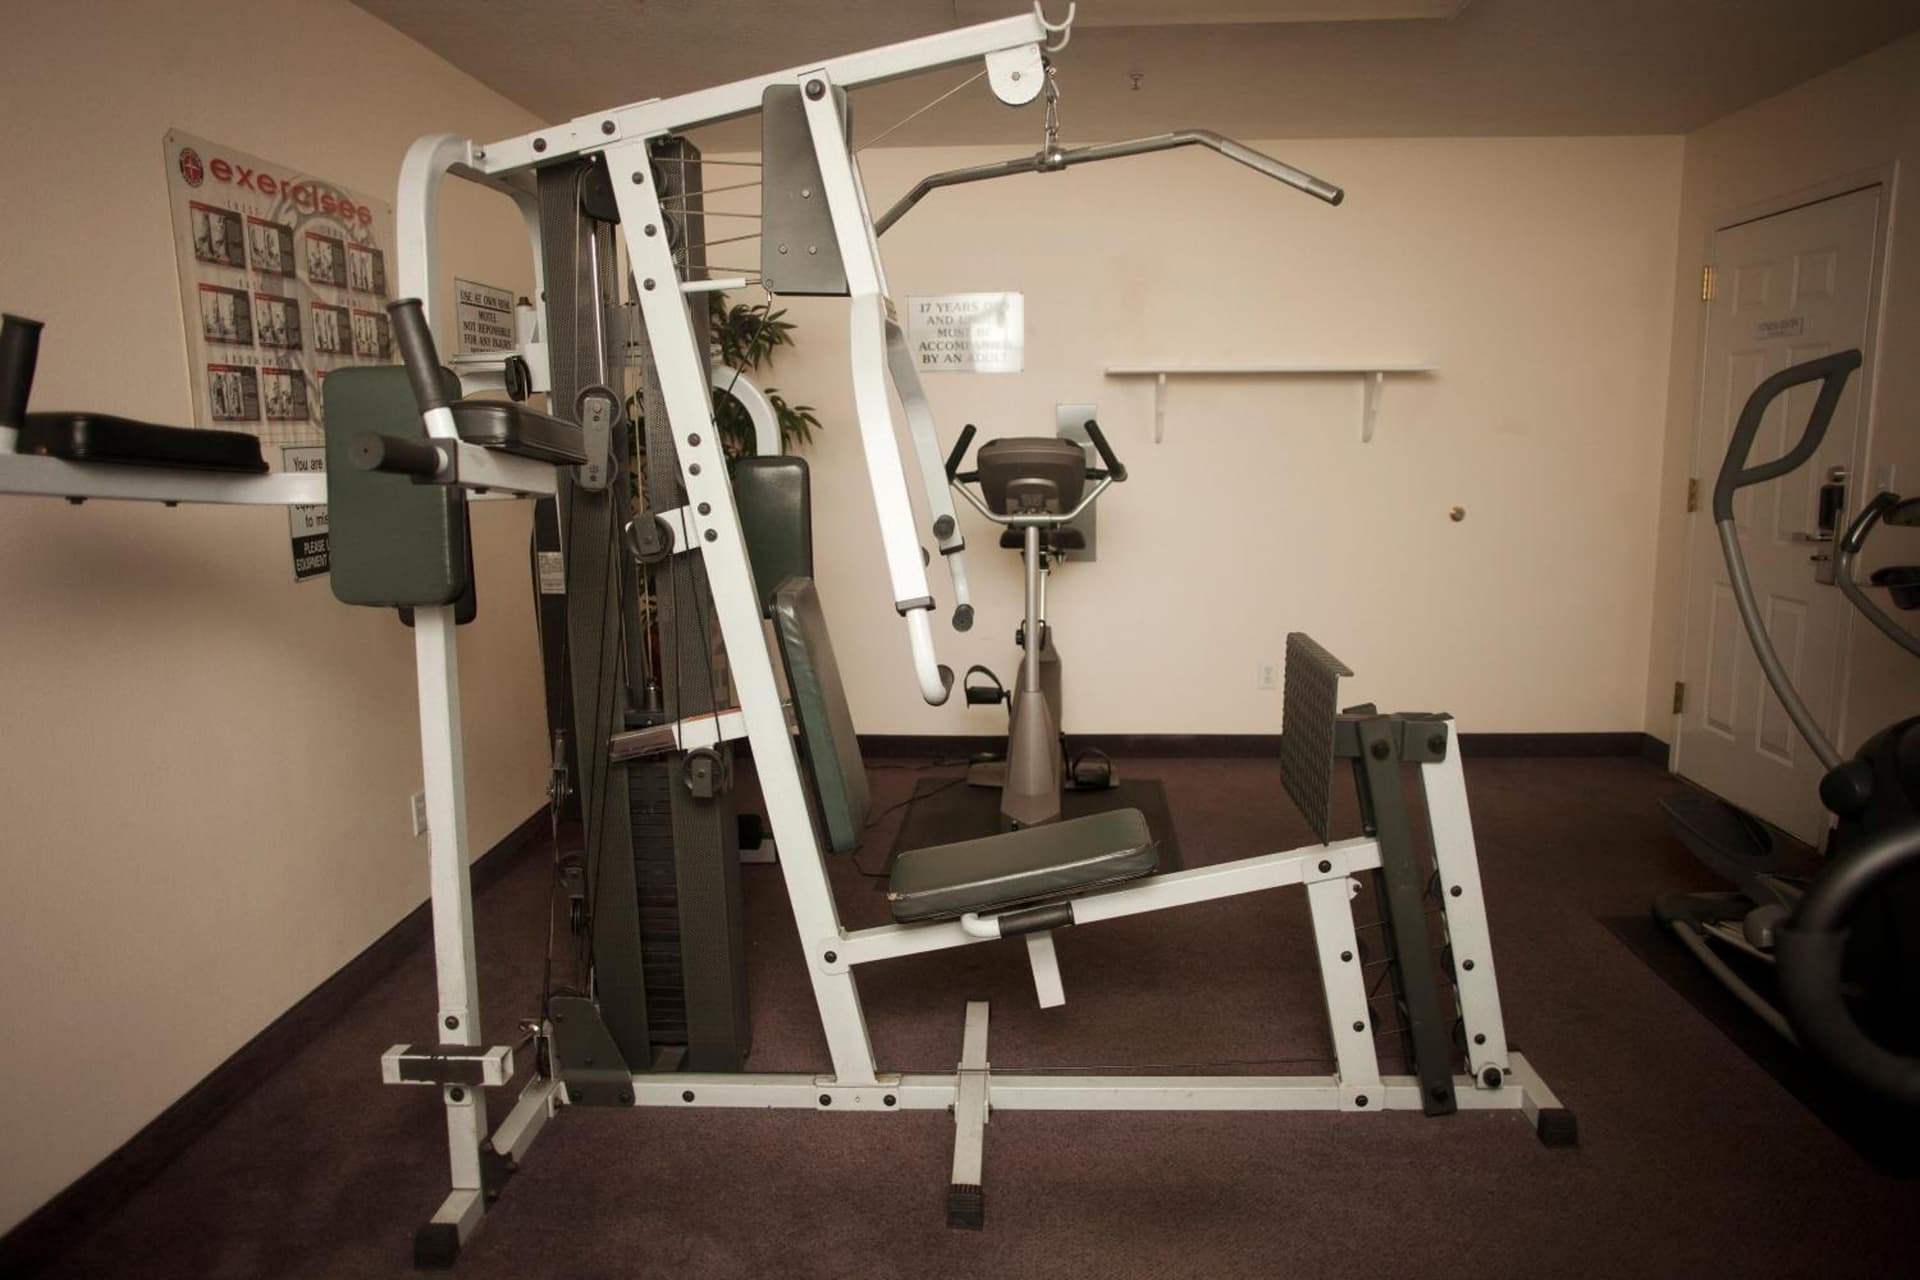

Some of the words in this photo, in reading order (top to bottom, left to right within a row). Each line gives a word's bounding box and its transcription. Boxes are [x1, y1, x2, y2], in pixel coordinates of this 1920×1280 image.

[209, 156, 373, 225] exercises
[484, 296, 496, 306] OWN
[920, 303, 932, 313] 17
[936, 302, 979, 312] YEARS
[463, 321, 476, 331] NOT
[926, 315, 954, 326] AND
[937, 328, 972, 338] MUST
[464, 334, 477, 344] FOR
[479, 336, 492, 346] ANY
[922, 354, 939, 364] BY
[944, 354, 962, 363] AN
[292, 457, 308, 472] You
[310, 458, 323, 470] are
[305, 514, 314, 528] to
[304, 542, 326, 554] PLEASE
